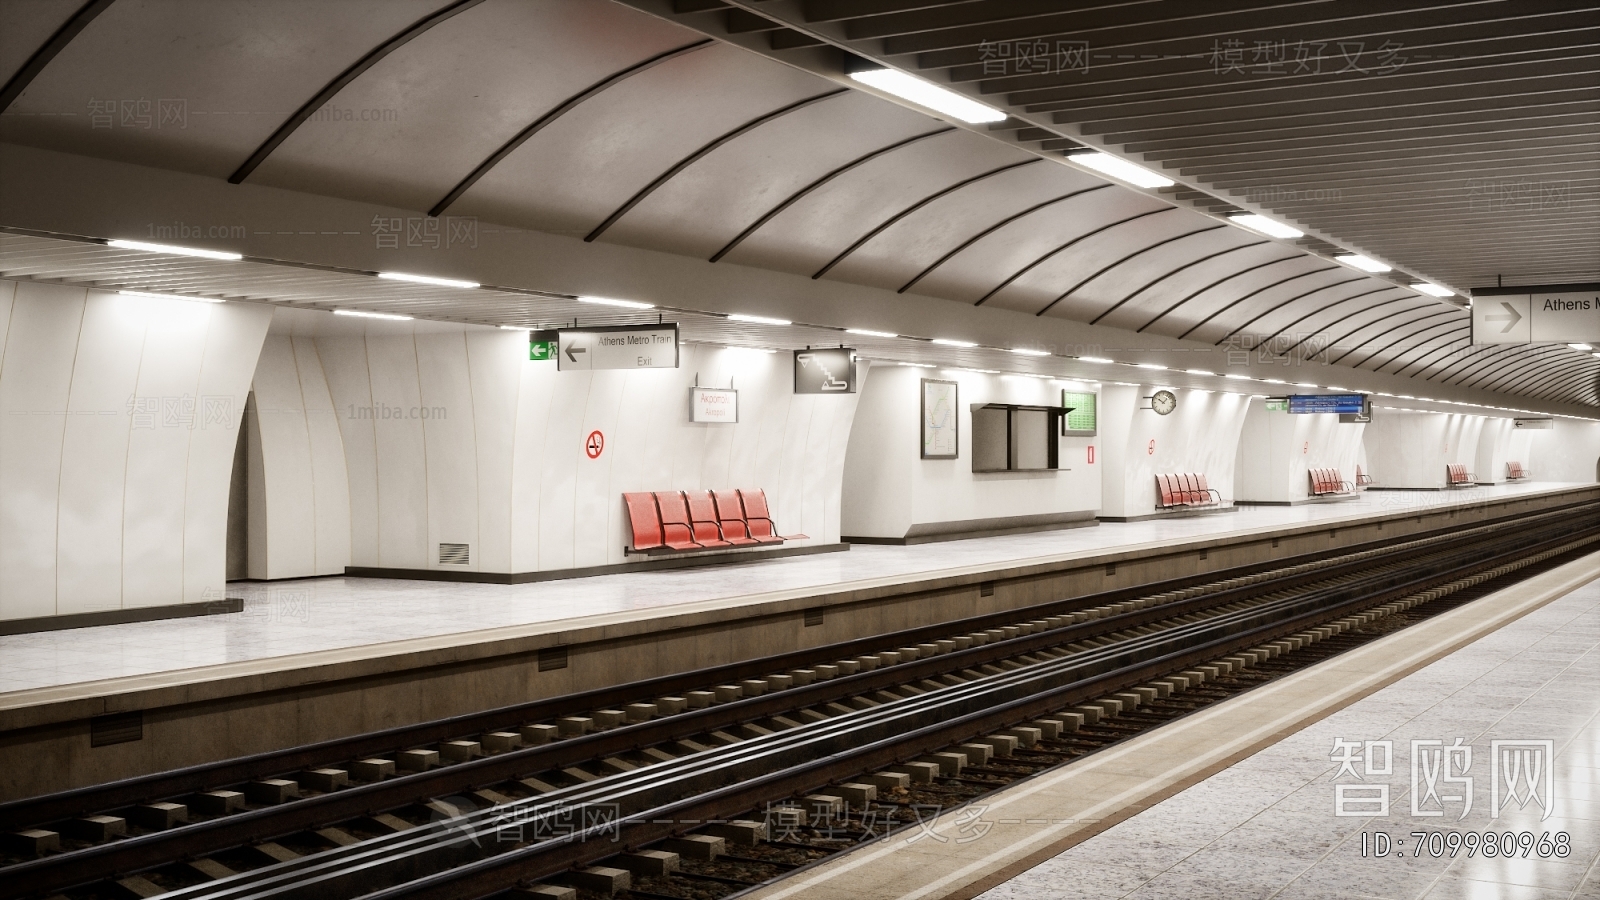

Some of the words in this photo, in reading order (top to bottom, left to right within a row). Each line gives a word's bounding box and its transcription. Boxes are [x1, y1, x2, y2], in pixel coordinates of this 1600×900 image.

[1543, 298, 1590, 311] Athens
[598, 336, 625, 346] Athens
[627, 335, 650, 345] Metro
[651, 334, 672, 344] Train
[637, 356, 652, 366] Exit
